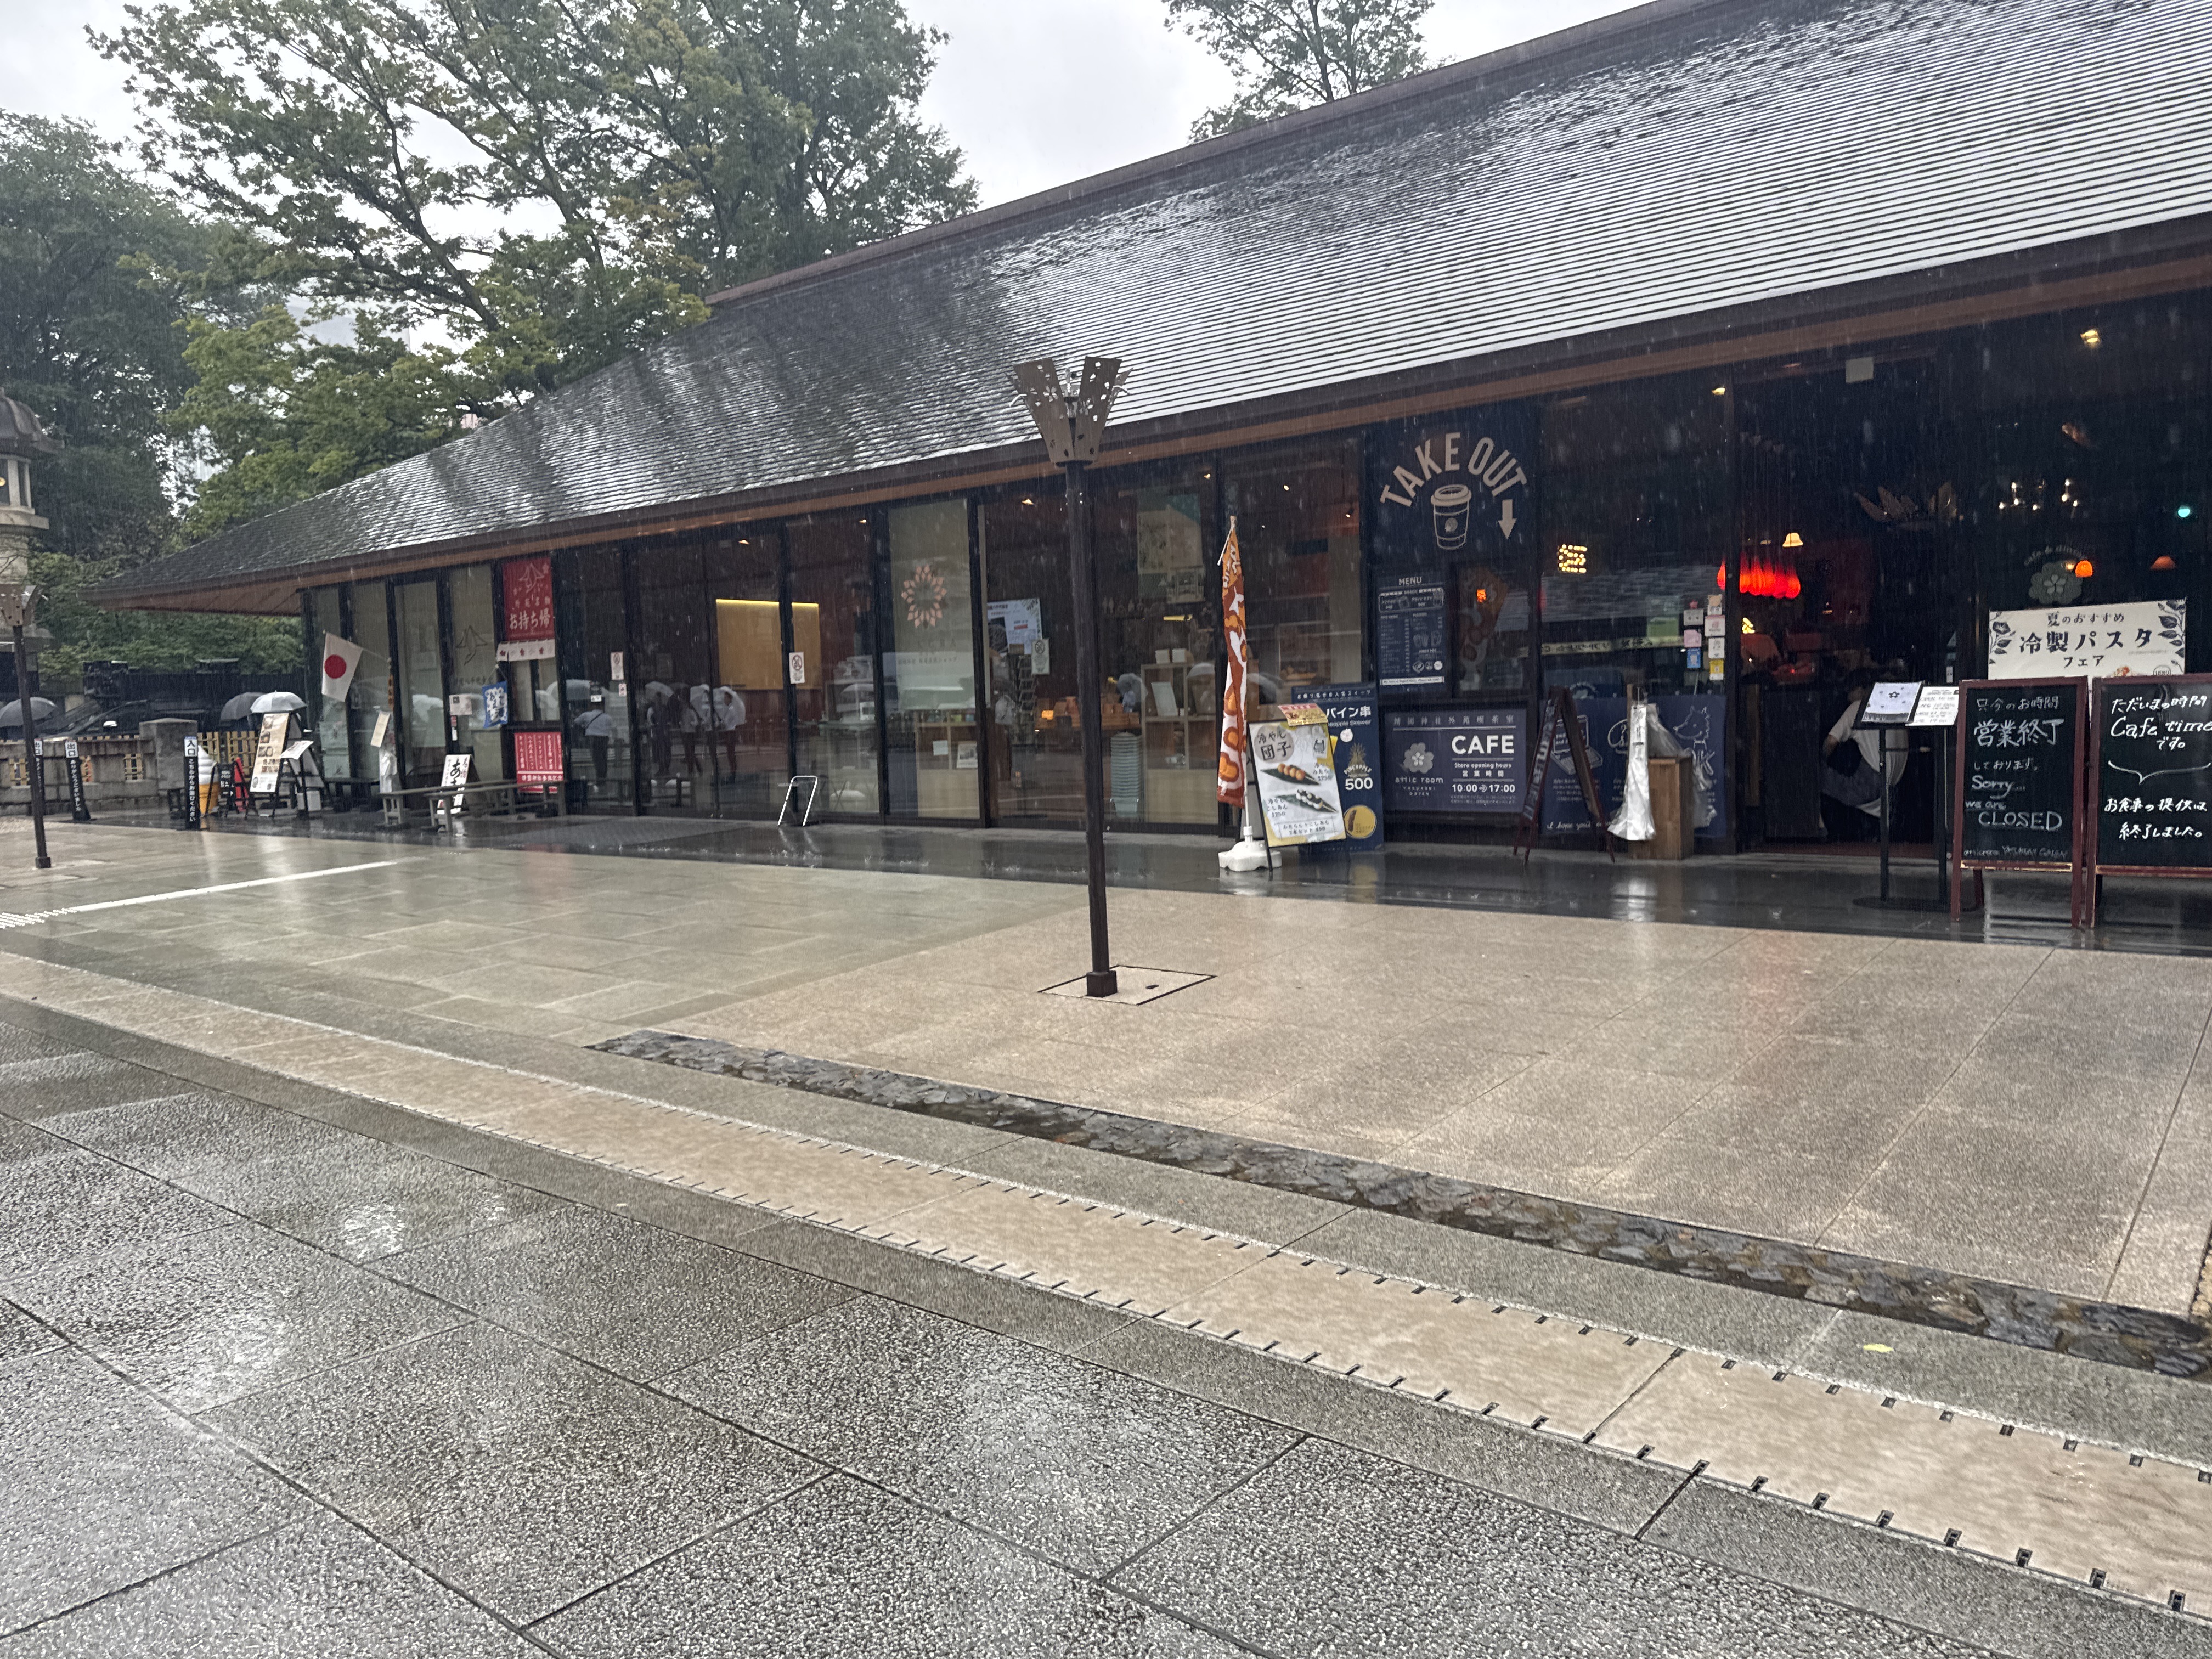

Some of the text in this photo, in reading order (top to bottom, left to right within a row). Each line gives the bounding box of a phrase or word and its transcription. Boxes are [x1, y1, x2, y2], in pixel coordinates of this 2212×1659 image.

[1379, 432, 1527, 507] TAKE OUT
[1399, 577, 1423, 585] MENU
[2047, 612, 2124, 627] 夏のおすすめ
[2019, 628, 2152, 654] 冷製パスタ
[2063, 655, 2104, 668] フェア
[1977, 696, 2058, 711] 只今のお時間
[2112, 696, 2207, 714] ただいまの時間
[1327, 706, 1372, 718] パイン串
[1973, 718, 2064, 747] 営業終了
[2111, 716, 2212, 739] Cafe time
[1257, 729, 1287, 744] 冷やし
[2157, 736, 2186, 751] です。
[67, 743, 76, 757] 出口
[187, 740, 196, 755] 入口
[1261, 741, 1291, 761] 団子
[1451, 735, 1514, 754] CAFE
[1974, 758, 2038, 771] しております。
[1345, 777, 1373, 791] 500
[1452, 784, 1515, 793] 10:00 17:00
[2104, 797, 2207, 812] お食事の提供は
[1978, 811, 2062, 831] CLOSED
[2119, 821, 2202, 840] 終了しました。
